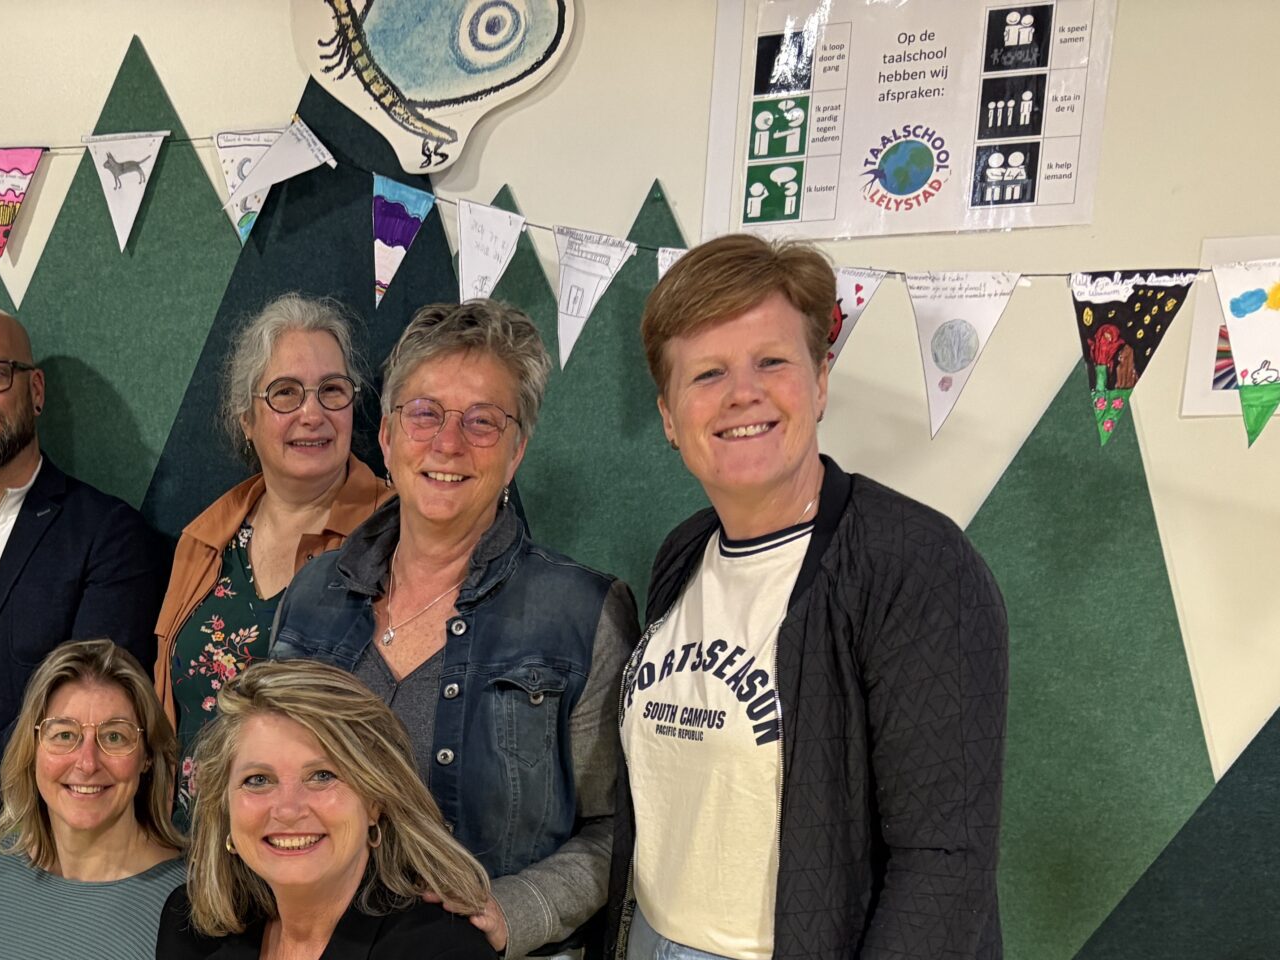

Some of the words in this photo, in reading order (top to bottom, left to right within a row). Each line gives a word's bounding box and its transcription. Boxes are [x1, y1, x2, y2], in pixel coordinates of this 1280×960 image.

[1058, 25, 1066, 33] Ik
[1067, 23, 1088, 34] speel
[897, 32, 916, 46] Op
[919, 29, 936, 42] de
[1059, 36, 1085, 45] samen
[829, 43, 845, 52] loop
[819, 54, 835, 62] door
[836, 52, 846, 60] de
[882, 46, 947, 65] taalschool
[822, 64, 840, 73] gang
[878, 70, 926, 84] hebben
[930, 65, 949, 80] wij
[878, 86, 945, 104] afspraken:
[1051, 94, 1059, 102] Ik
[1060, 94, 1071, 102] sta
[1073, 93, 1081, 101] in
[815, 104, 821, 112] Ik
[823, 104, 841, 113] praat
[1055, 104, 1065, 113] de
[1066, 104, 1075, 113] rij
[816, 114, 838, 124] aardig
[816, 125, 836, 134] tegen
[811, 134, 840, 144] anderen
[863, 124, 950, 173] TAALSCHOOL
[1047, 162, 1054, 170] Ik
[1055, 161, 1072, 170] help
[1044, 172, 1073, 181] iemand
[814, 184, 836, 193] luister
[869, 179, 942, 212] LELYSTAD
[643, 700, 678, 723] SOUTH
[680, 706, 726, 729] CAMPUS
[655, 723, 677, 737] PACIFIC
[678, 727, 704, 741] REPUBLIC
